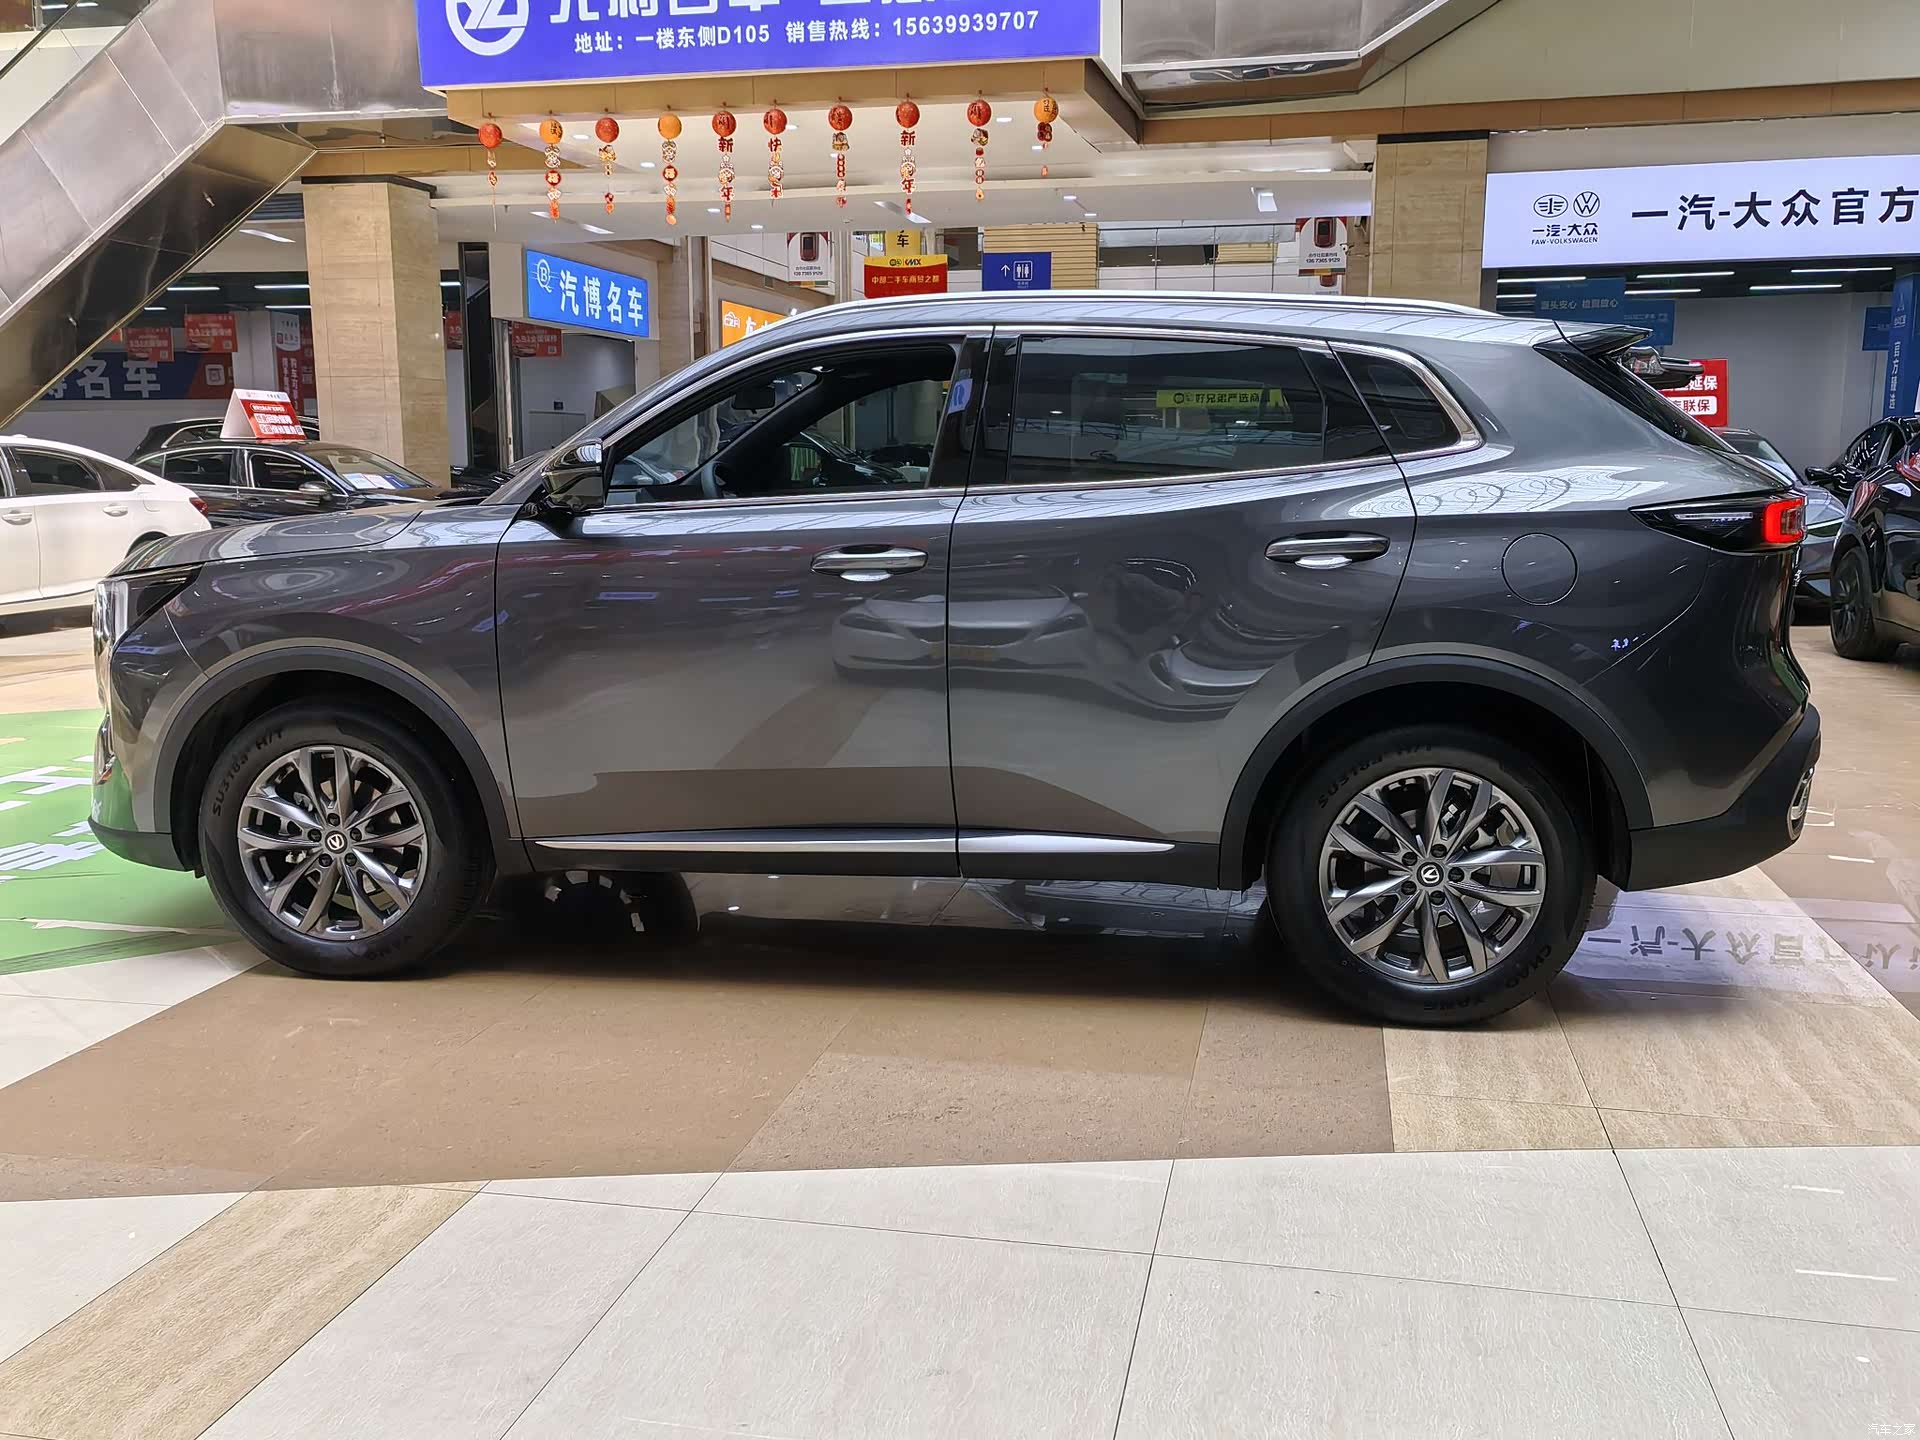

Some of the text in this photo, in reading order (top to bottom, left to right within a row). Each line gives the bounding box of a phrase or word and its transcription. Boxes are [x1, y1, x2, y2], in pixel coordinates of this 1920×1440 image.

[785, 10, 1039, 43] 销售热线：15639939707
[1531, 237, 1598, 245] FAW-VOLKSWAGEN
[560, 269, 643, 328] 汽博名车
